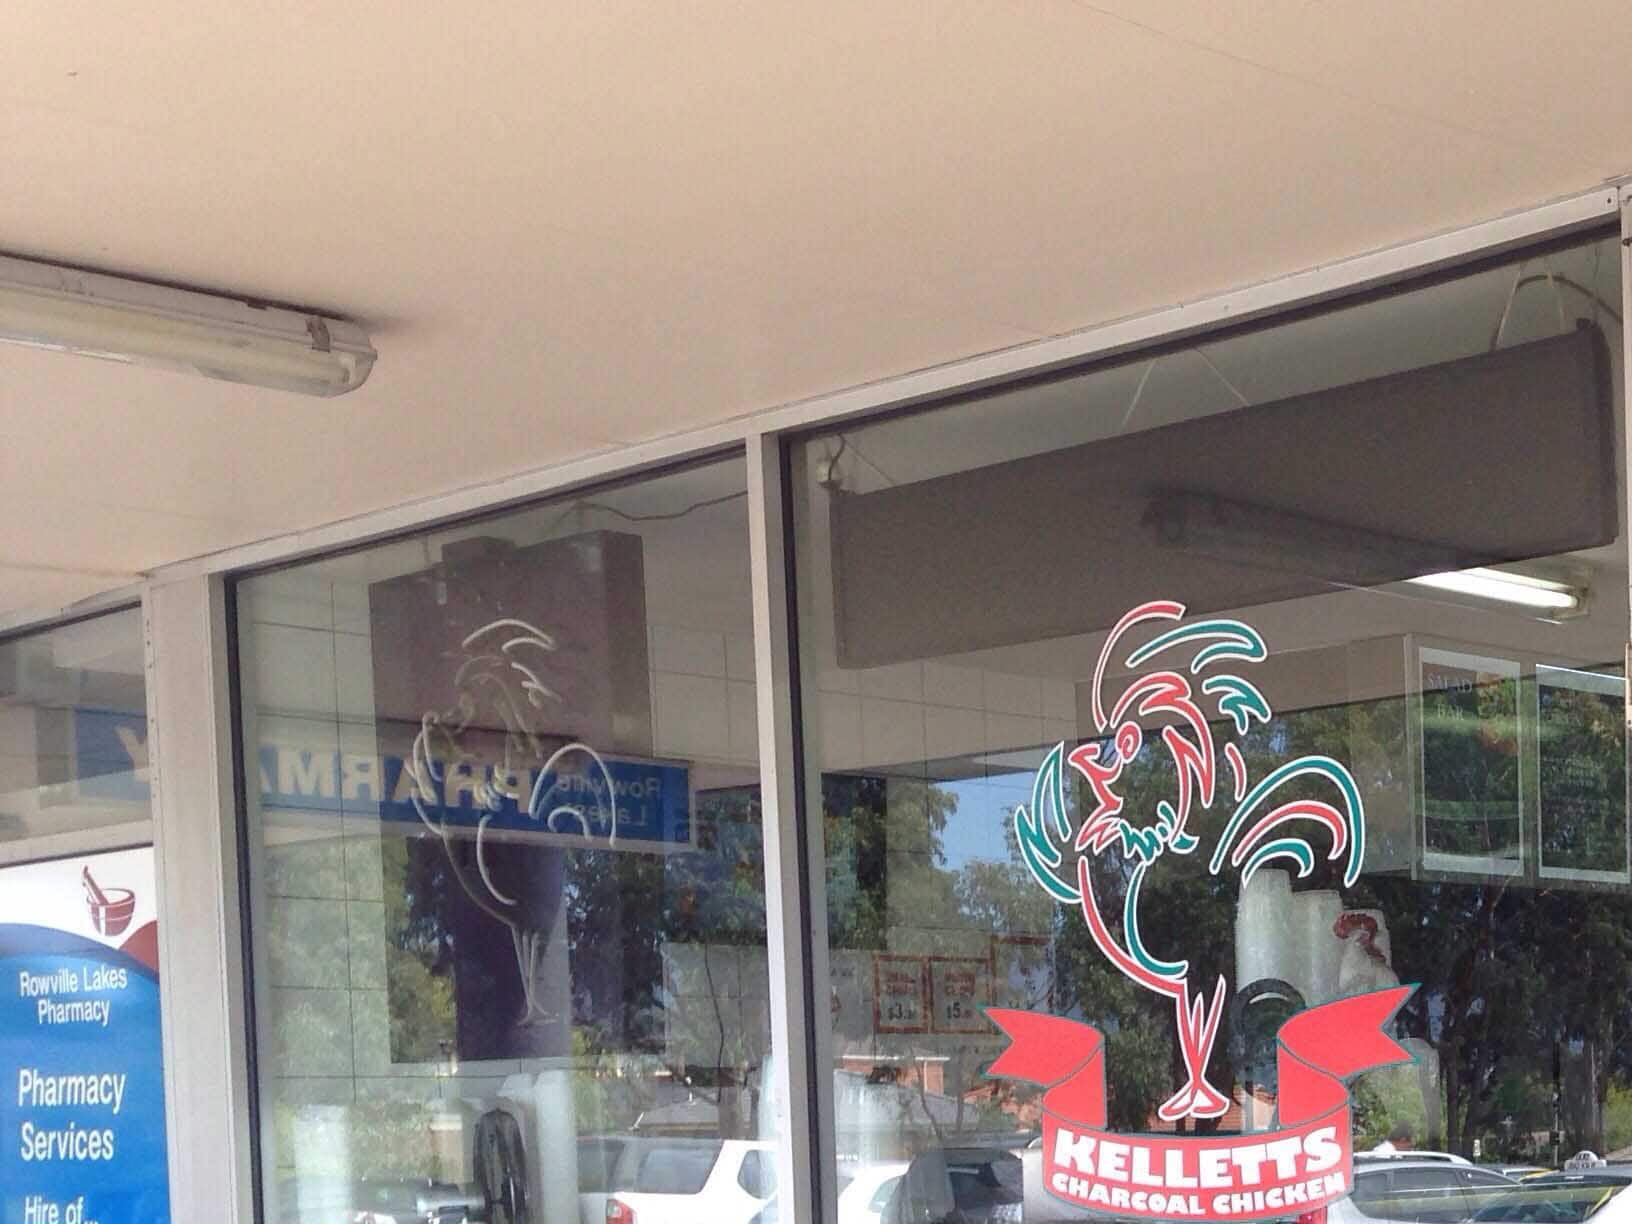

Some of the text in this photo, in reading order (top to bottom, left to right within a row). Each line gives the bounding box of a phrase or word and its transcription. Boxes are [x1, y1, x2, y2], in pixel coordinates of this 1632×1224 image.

[19, 965, 128, 998] Rowville Lakes
[38, 998, 110, 1026] Pharmacy
[18, 1068, 126, 1115] Pharmacy
[20, 1121, 114, 1161] Services
[1052, 1125, 1343, 1189] KELLETTS
[1051, 1171, 1347, 1216] CHARCOAL CHICKEN
